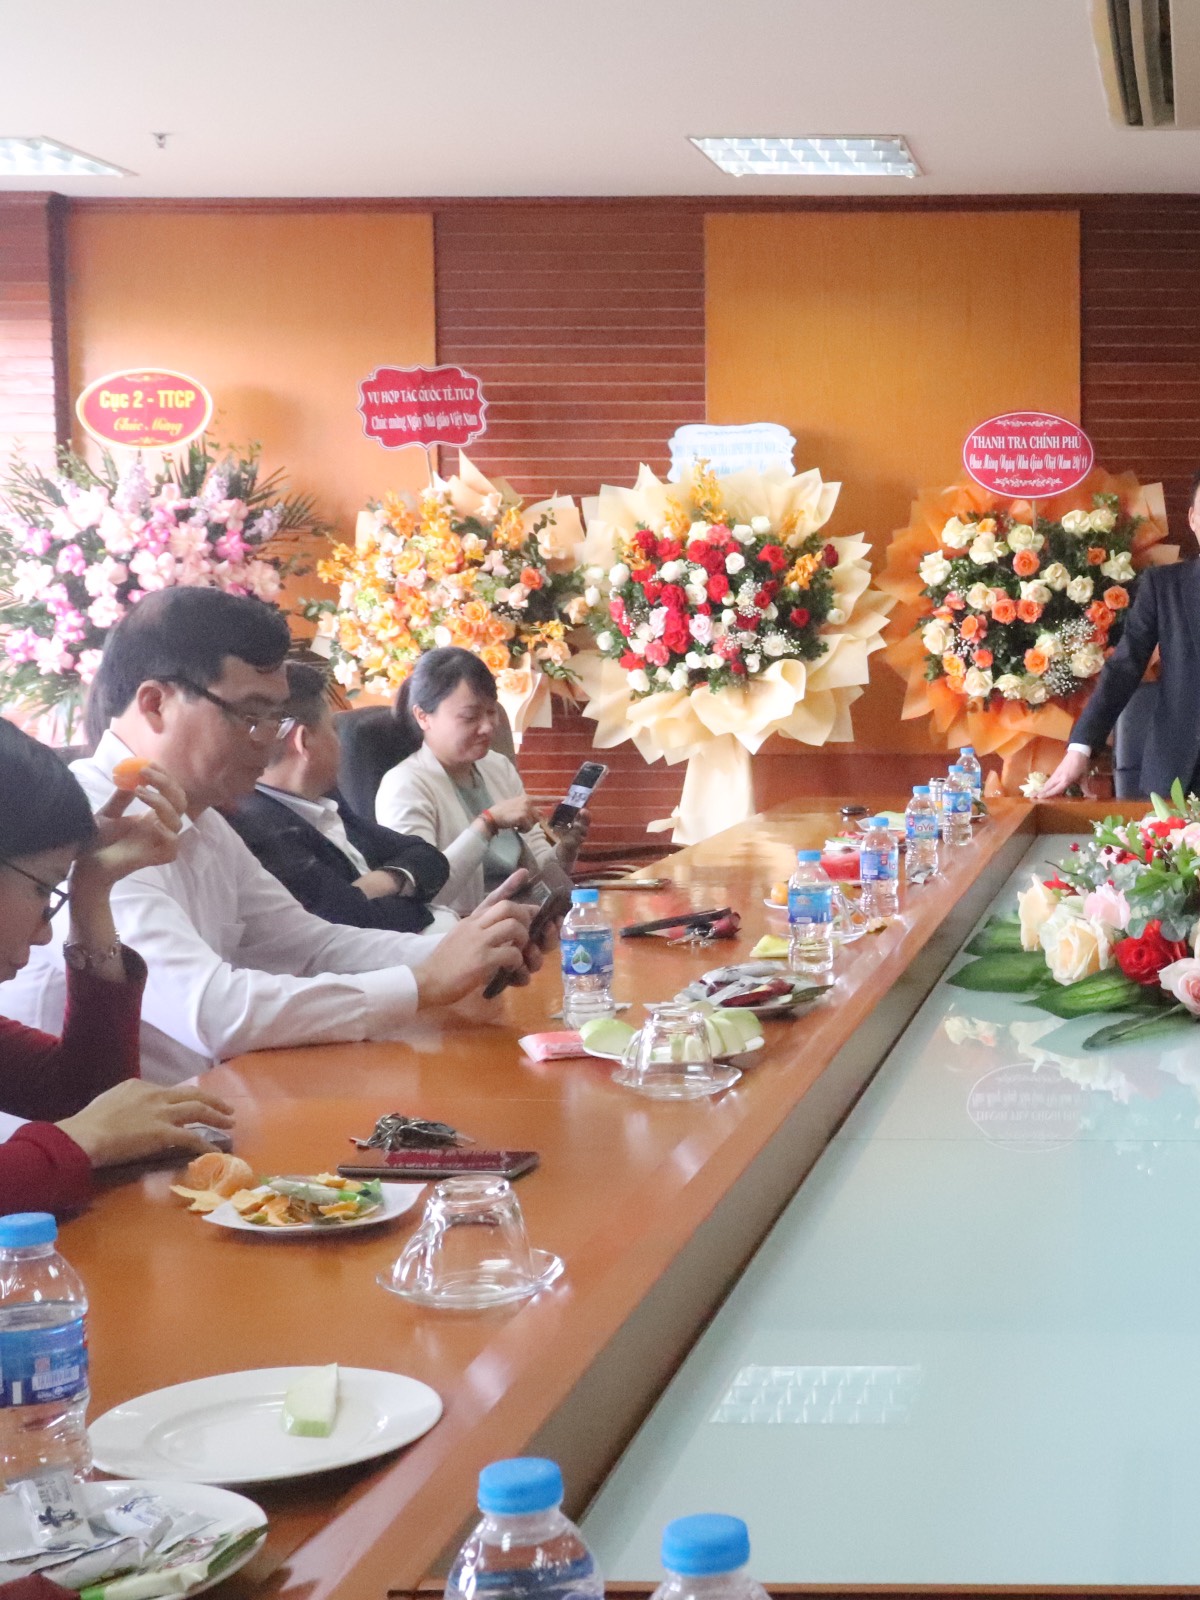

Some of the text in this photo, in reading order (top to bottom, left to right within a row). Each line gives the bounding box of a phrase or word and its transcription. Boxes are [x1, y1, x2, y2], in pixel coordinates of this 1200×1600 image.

[99, 390, 129, 412] Cục
[133, 390, 143, 408] 2
[157, 390, 196, 408] TTCP
[367, 391, 380, 407] VỤ
[382, 390, 400, 405] HỢP
[401, 386, 418, 402] TÁC
[972, 431, 1082, 449] THANH TRA CHÍNH PHỦ
[1057, 454, 1071, 470] Nam
